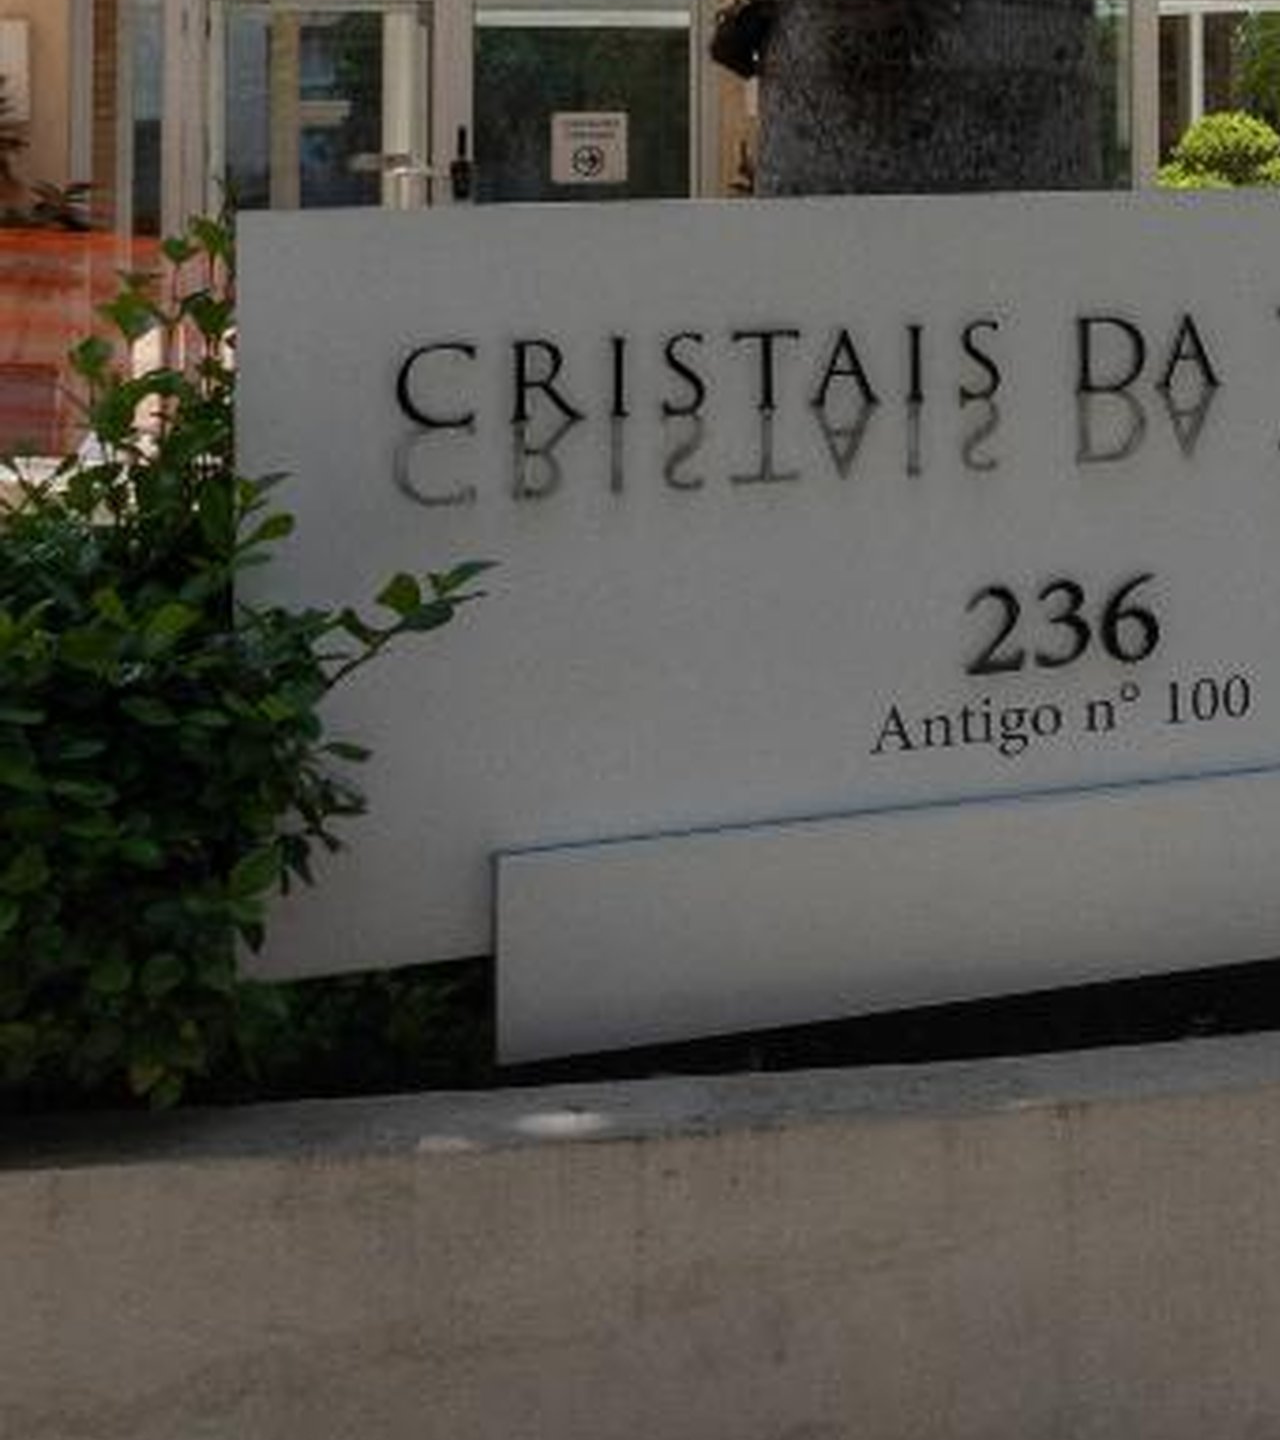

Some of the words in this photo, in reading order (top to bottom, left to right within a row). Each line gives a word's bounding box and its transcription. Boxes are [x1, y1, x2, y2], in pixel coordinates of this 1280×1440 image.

[394, 319, 1002, 429] CRISTAIS
[1075, 312, 1221, 394] DA
[964, 571, 1161, 676] 236
[870, 696, 1064, 758] Antigo
[1166, 674, 1253, 725] 100
